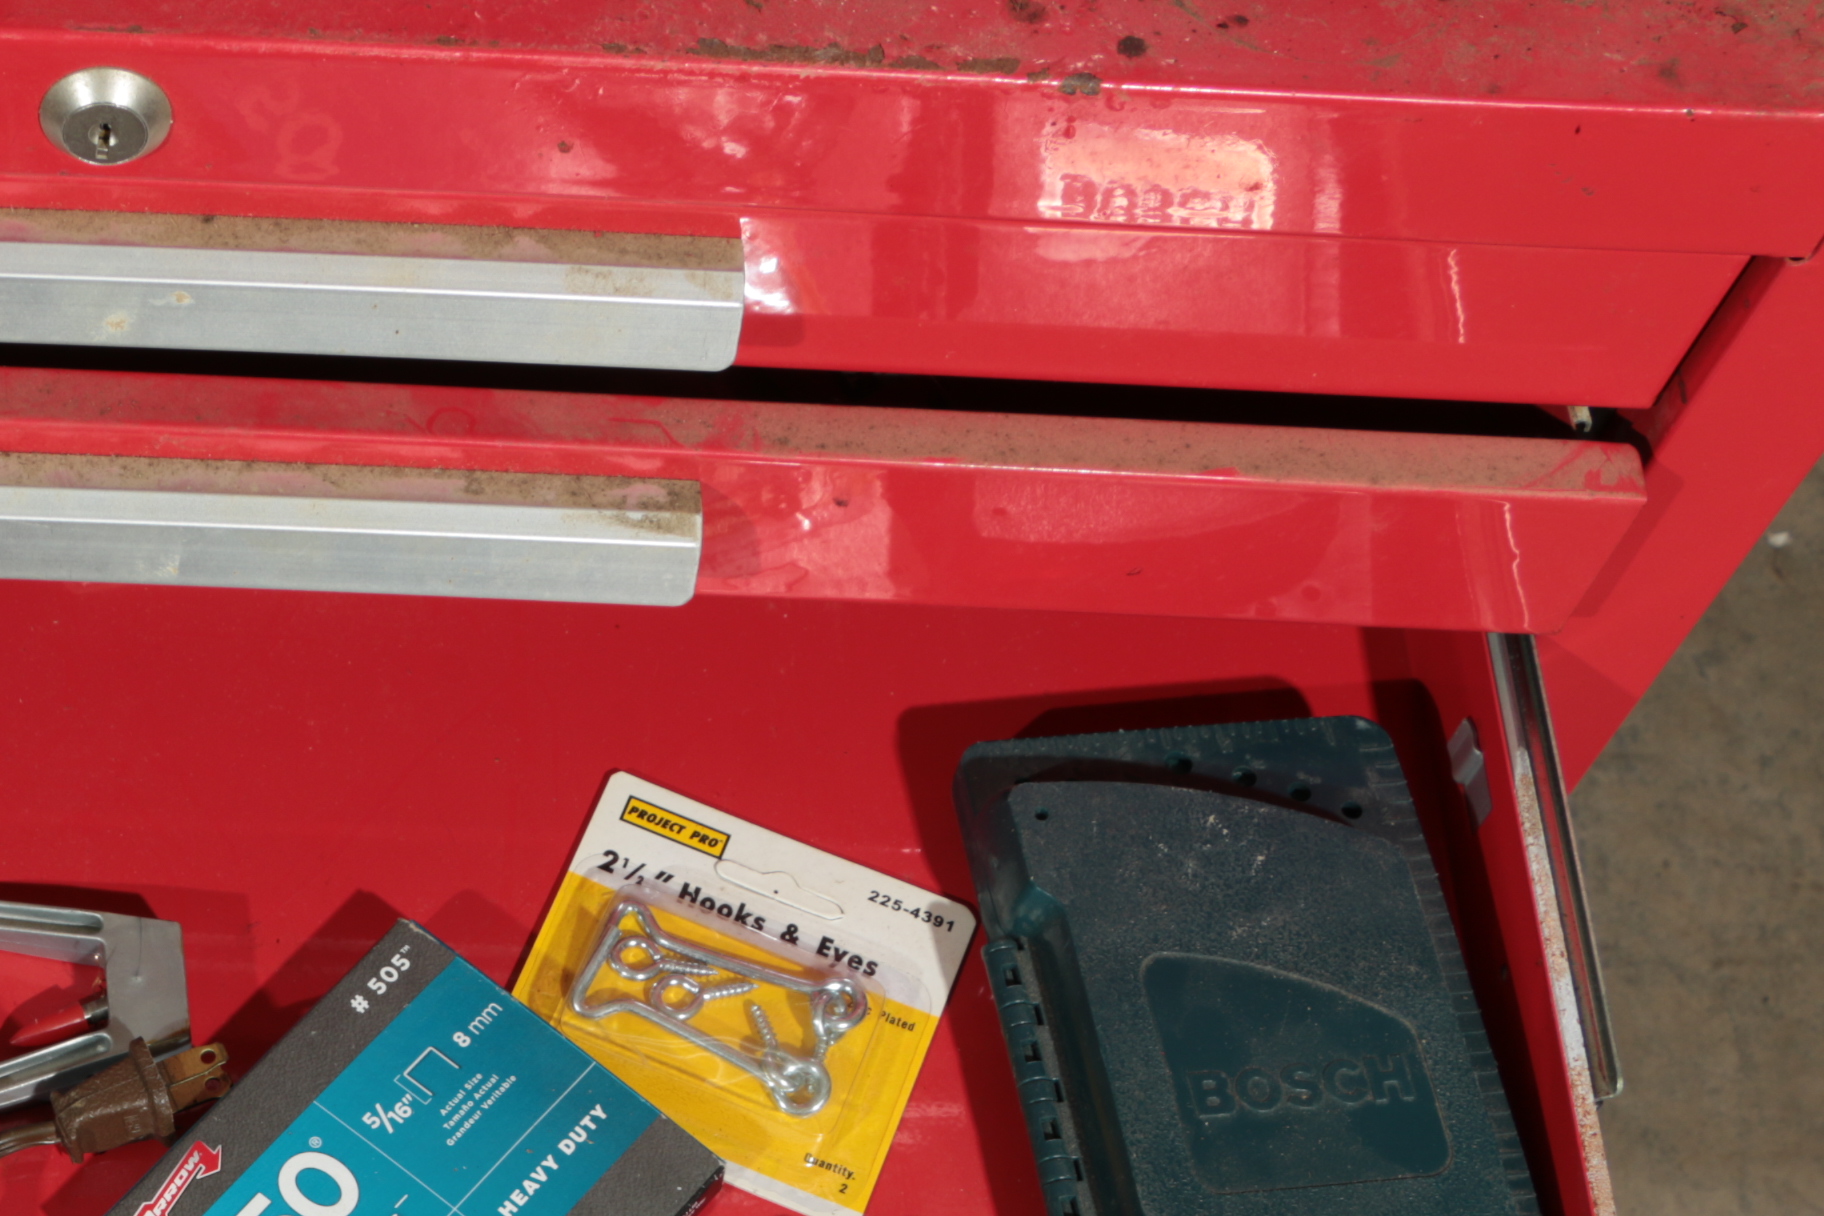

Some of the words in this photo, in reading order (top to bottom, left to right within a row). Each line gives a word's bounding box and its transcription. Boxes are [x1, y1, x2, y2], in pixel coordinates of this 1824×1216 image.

[626, 805, 687, 837] PROJECT
[689, 829, 721, 850] PRO
[677, 882, 766, 933] Hooks
[779, 924, 800, 947] &
[815, 936, 881, 979] Eyes
[866, 889, 956, 934] 225-4391
[452, 1030, 472, 1050] 8
[466, 1001, 505, 1038] mm
[440, 1089, 467, 1117] Actual
[463, 1072, 484, 1091] Size
[442, 1100, 475, 1131] Tamaño
[472, 1073, 500, 1101] Actual
[445, 1109, 484, 1147] Grandeur
[480, 1074, 518, 1111] Veritable
[1185, 1053, 1416, 1123] BOSCH
[557, 1102, 609, 1158] DUTY
[839, 1182, 849, 1195] 2
